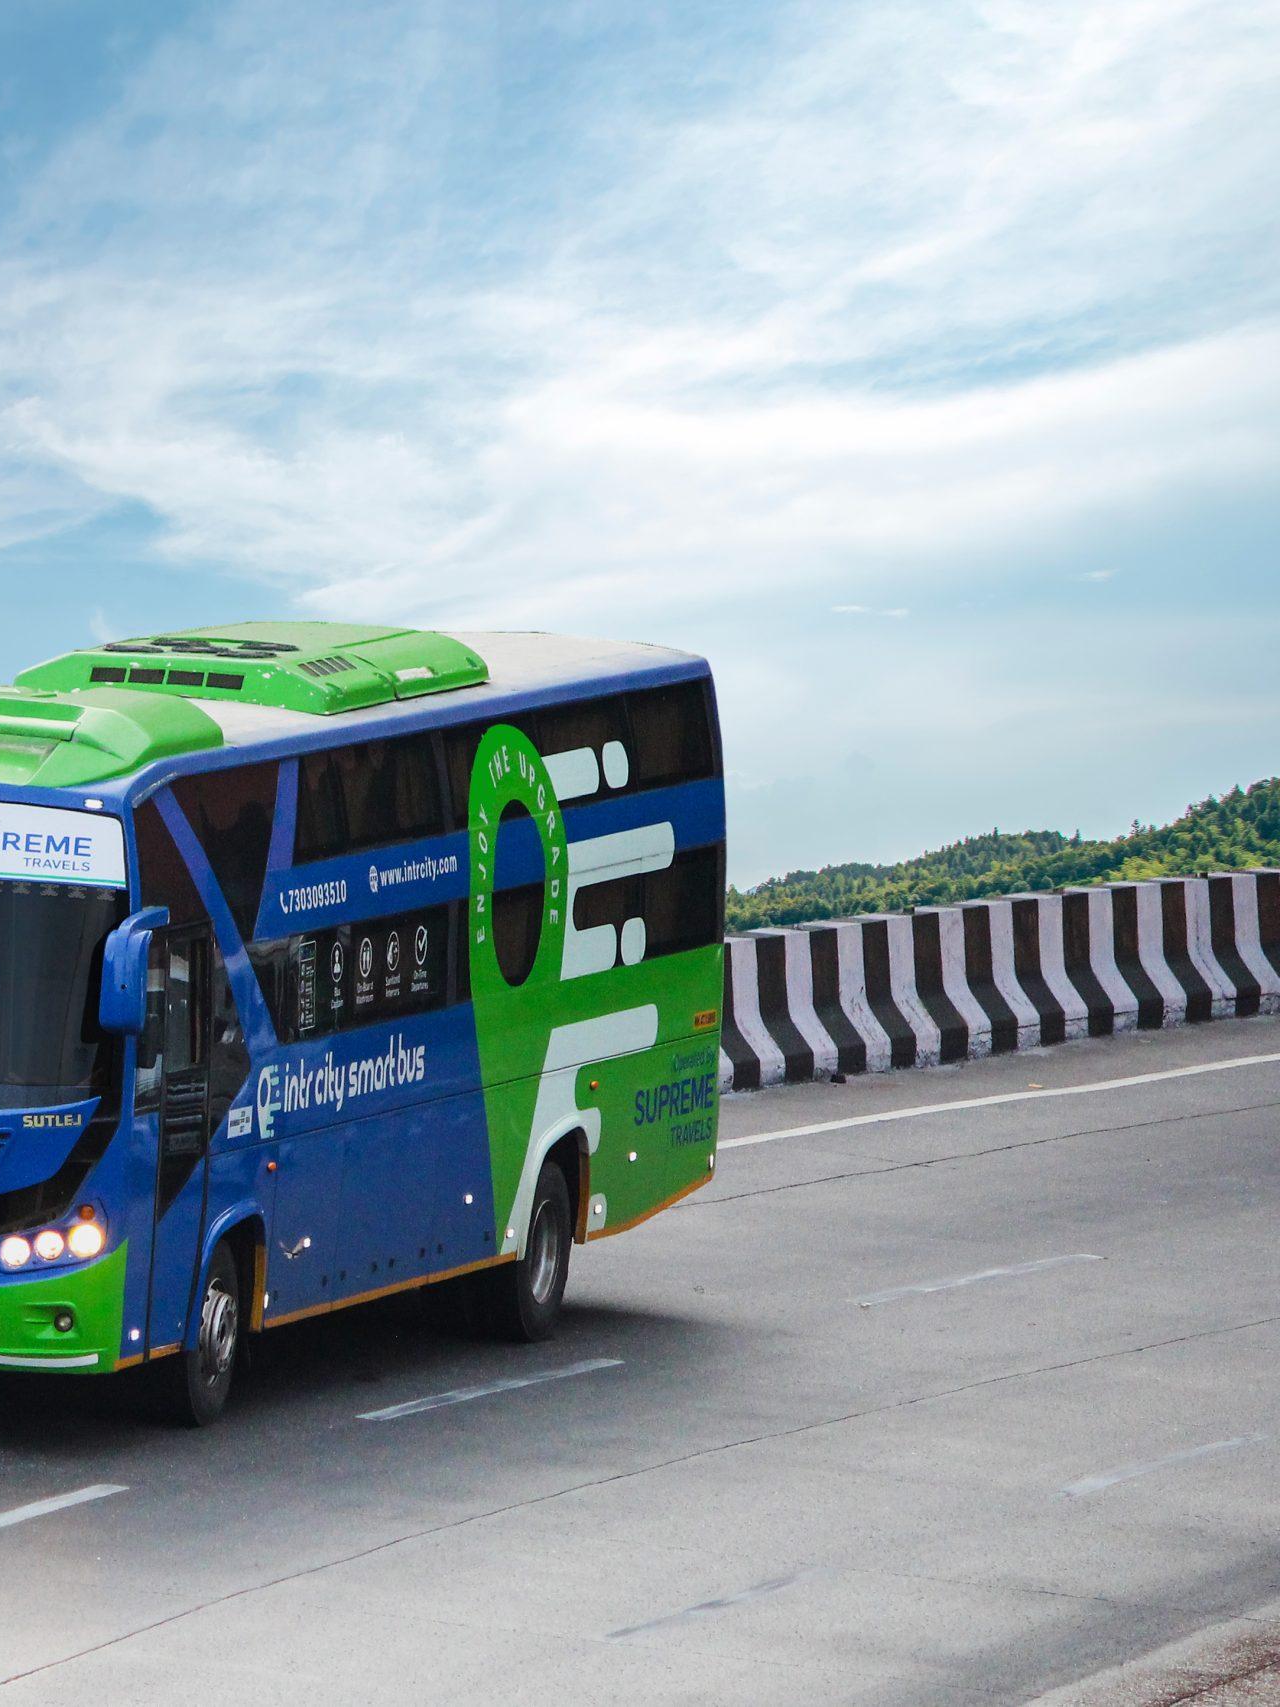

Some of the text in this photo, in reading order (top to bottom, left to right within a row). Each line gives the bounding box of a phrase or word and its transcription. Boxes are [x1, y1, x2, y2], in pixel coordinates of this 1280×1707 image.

[476, 744, 561, 945] ENJOY THE UPGRADE
[24, 857, 91, 872] TRAVELS
[379, 854, 458, 888] www.intrcity.com
[288, 879, 347, 913] 7303093510
[283, 1032, 426, 1113] intr city smart bus
[634, 1072, 717, 1126] SUPREME
[22, 1113, 82, 1129] SUTLEJ
[671, 1116, 713, 1147] TRAVELS
